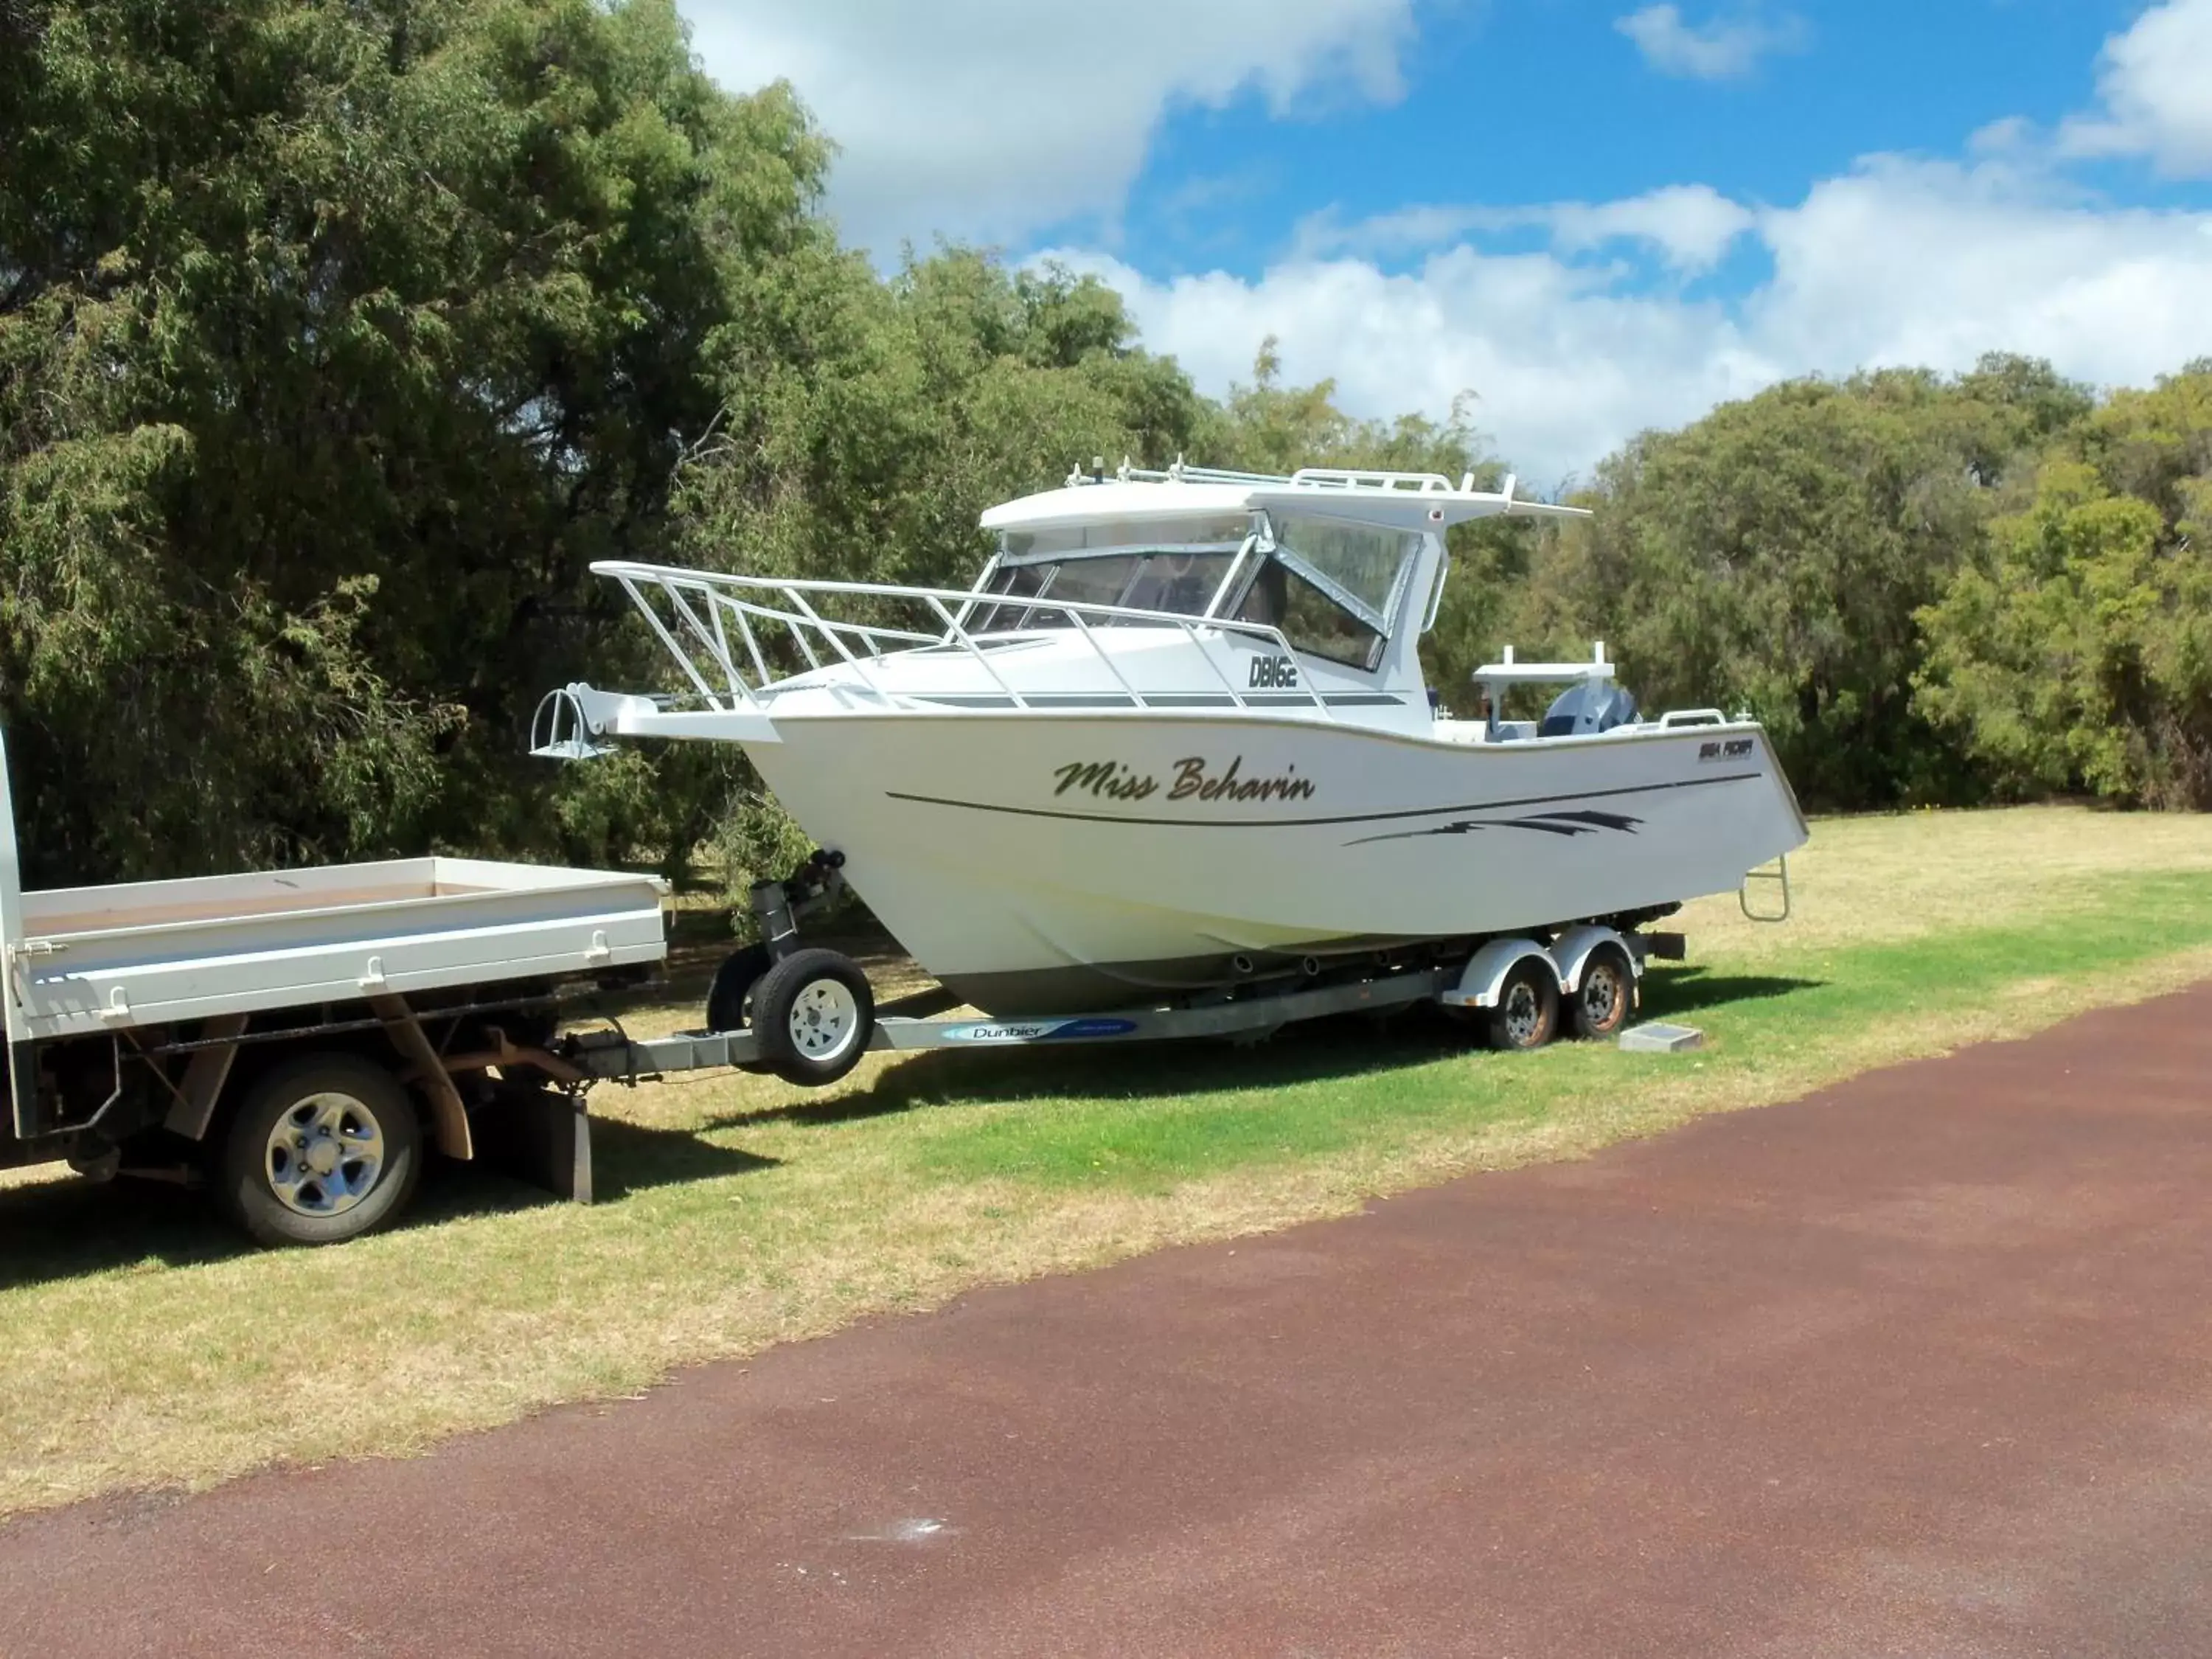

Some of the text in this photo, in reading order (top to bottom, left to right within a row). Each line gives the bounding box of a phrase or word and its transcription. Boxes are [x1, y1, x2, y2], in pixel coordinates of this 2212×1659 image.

[1054, 755, 1315, 802] Miss Behavin
[973, 1025, 1042, 1039] Dunbier
